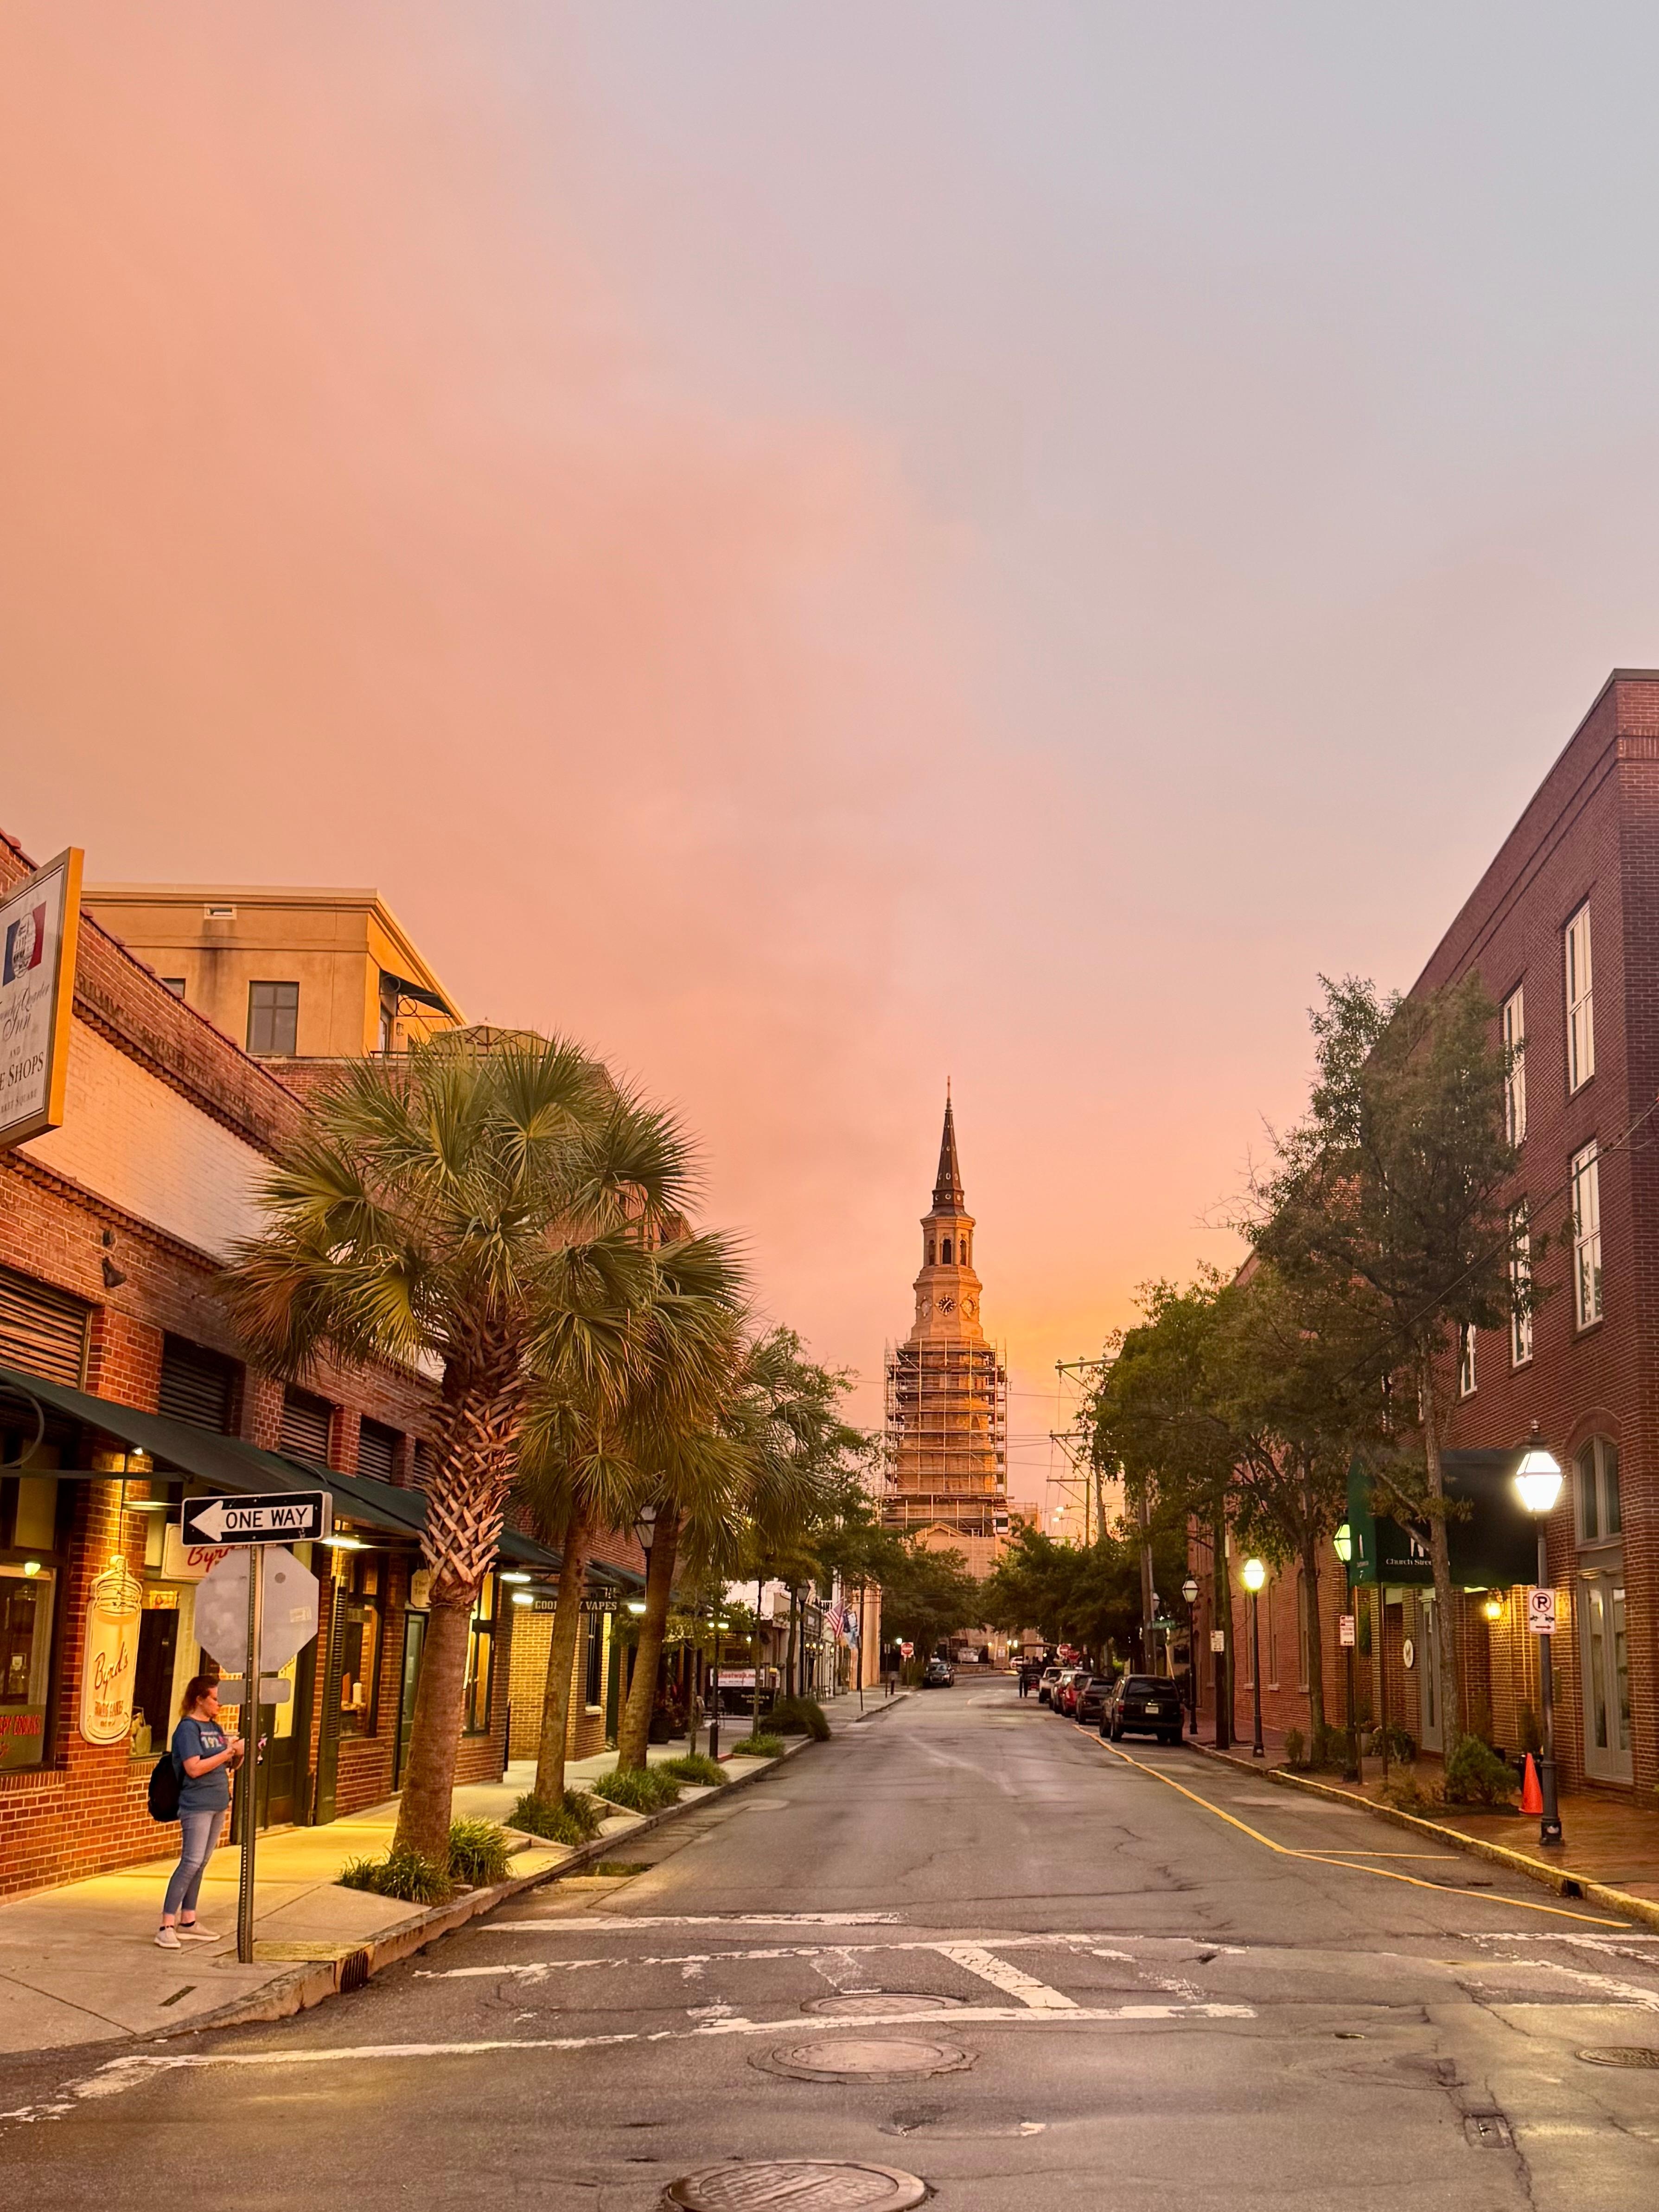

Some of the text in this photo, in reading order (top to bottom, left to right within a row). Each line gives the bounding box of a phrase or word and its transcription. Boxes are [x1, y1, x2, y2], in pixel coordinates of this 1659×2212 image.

[8, 1051, 44, 1087] SHOPS
[16, 1088, 37, 1106] SQUARE
[226, 1507, 307, 1529] ONE WAY
[187, 1546, 235, 1573] Byr
[586, 1601, 617, 1610] VAPES
[94, 1641, 128, 1701] Byrd's
